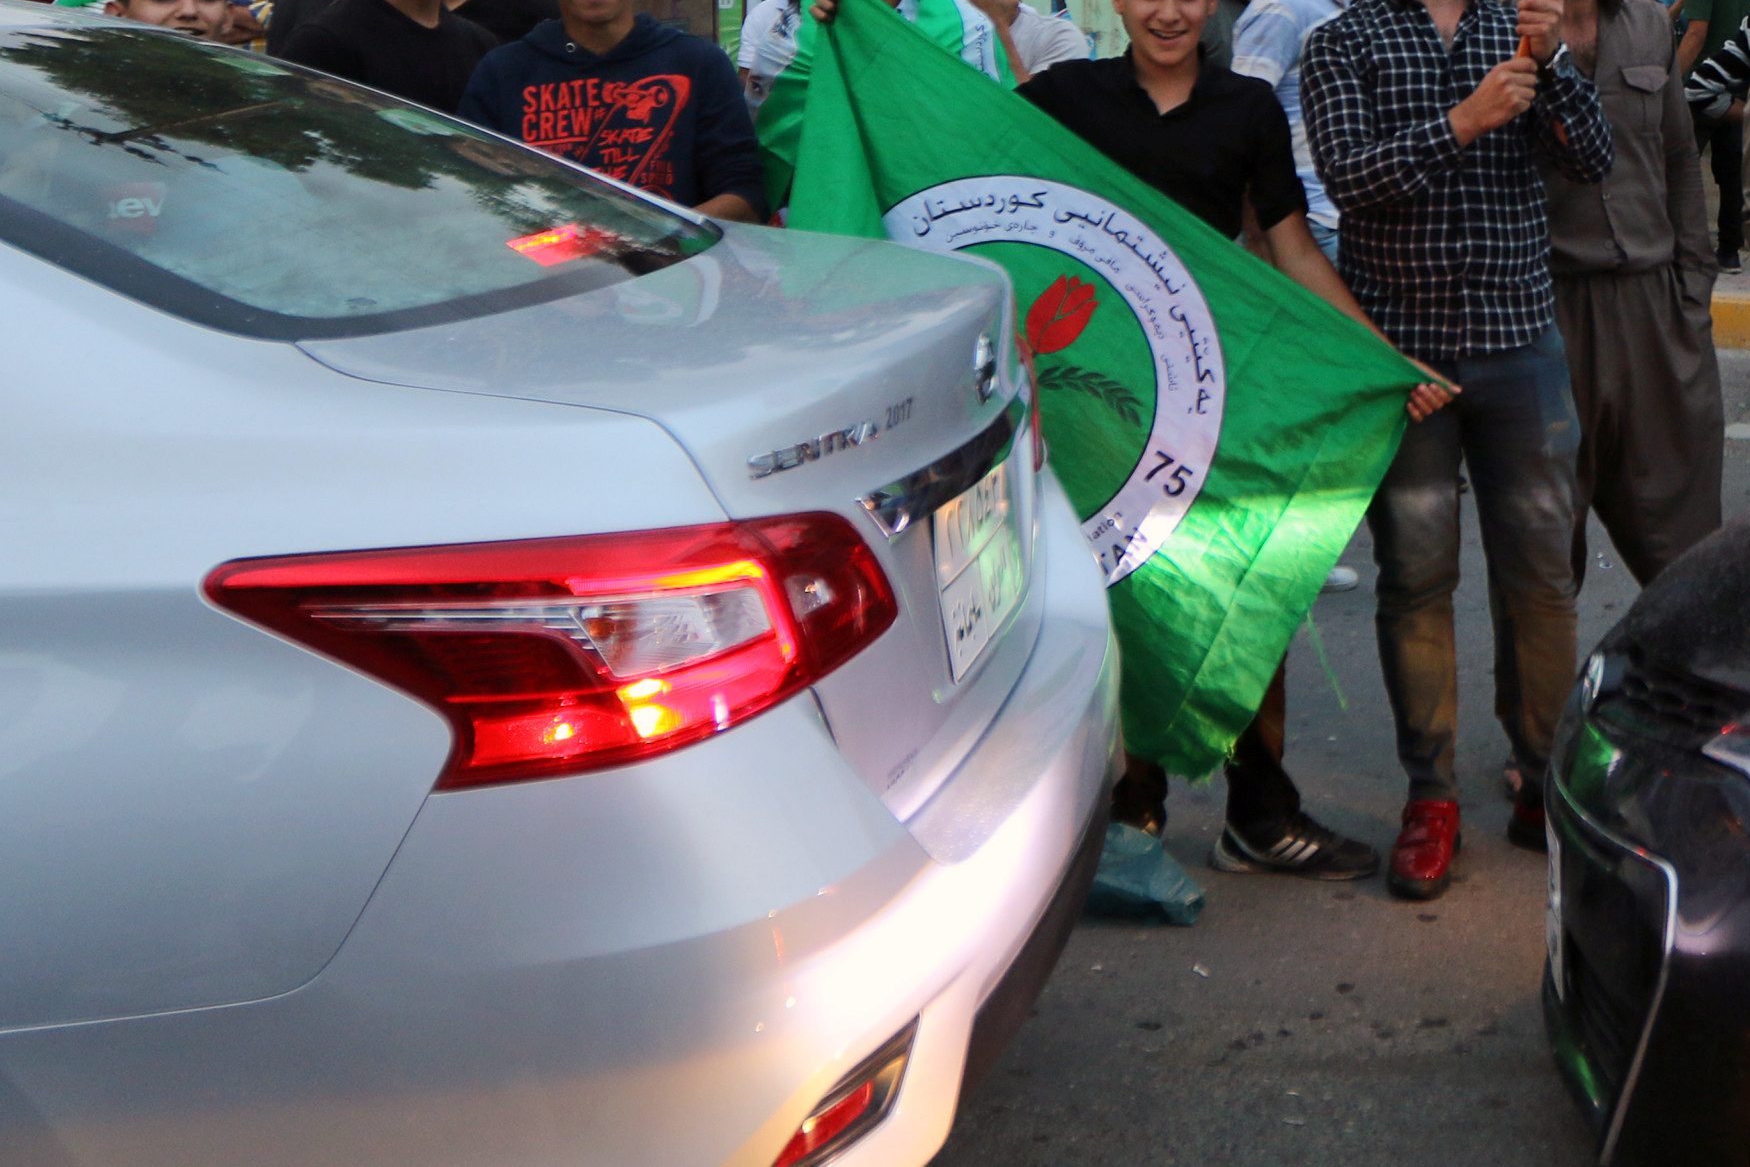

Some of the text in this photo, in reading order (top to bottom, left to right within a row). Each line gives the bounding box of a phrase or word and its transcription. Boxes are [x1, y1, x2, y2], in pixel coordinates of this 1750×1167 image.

[522, 78, 600, 113] SKATE
[522, 108, 592, 142] CREW
[598, 127, 654, 145] SKATE
[912, 191, 1048, 237] کوردستان
[885, 396, 914, 431] 2017
[1144, 450, 1193, 497] 75
